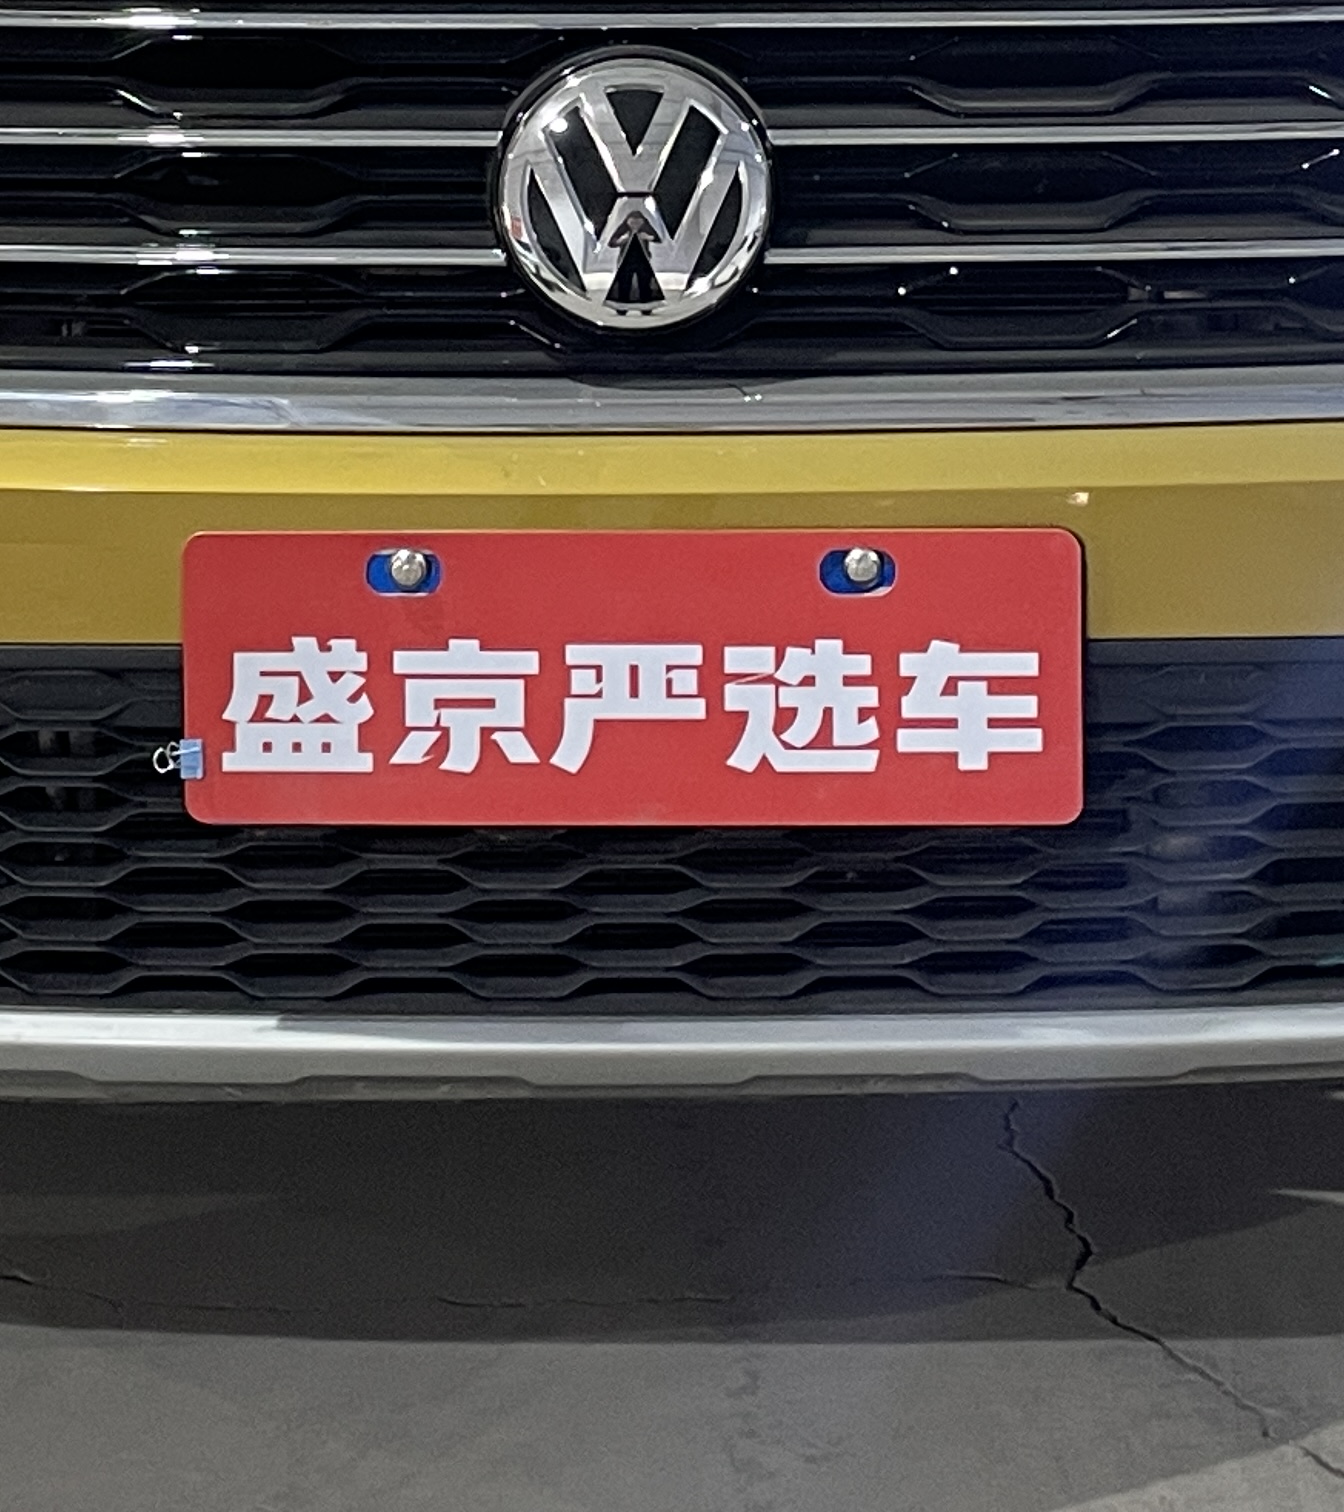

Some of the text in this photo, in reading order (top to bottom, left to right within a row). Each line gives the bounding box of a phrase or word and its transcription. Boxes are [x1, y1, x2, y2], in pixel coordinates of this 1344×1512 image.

[221, 635, 1045, 775] 盛京严选车
